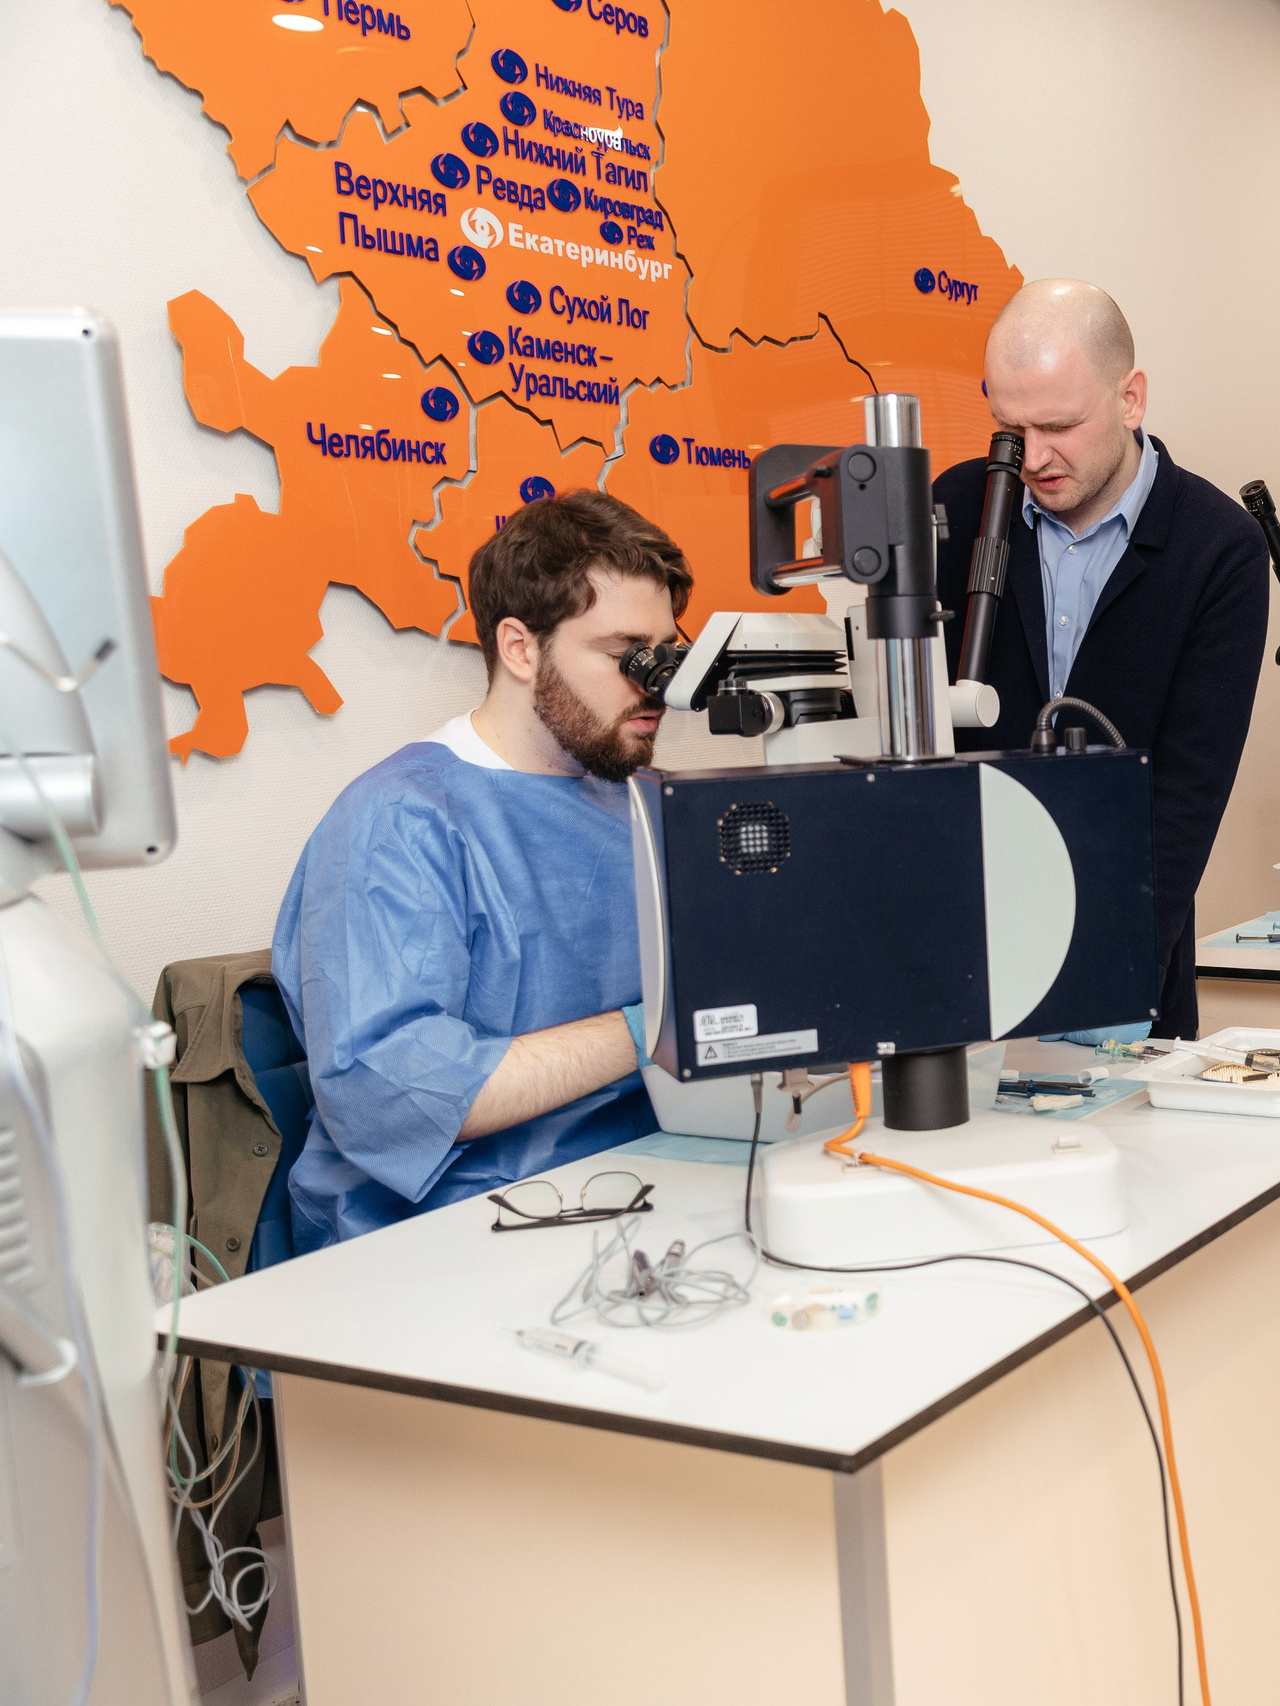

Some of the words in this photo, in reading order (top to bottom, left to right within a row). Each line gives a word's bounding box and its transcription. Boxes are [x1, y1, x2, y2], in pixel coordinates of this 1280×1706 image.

[587, 0, 649, 37] Серов
[535, 64, 602, 105] Нижняя
[605, 86, 645, 120] Тура
[504, 126, 586, 176] Нижний
[591, 151, 648, 192] Тагил
[335, 161, 447, 216] Верхняя
[476, 164, 545, 210] Ревда
[584, 186, 664, 231] Кировград
[338, 212, 439, 262] Пышма
[508, 223, 673, 283] Екатеринбург
[627, 226, 655, 251] Реж
[549, 285, 612, 323] Сухой
[617, 298, 649, 329] Лог
[938, 271, 978, 305] Сургут
[510, 363, 620, 405] Уральский
[306, 422, 446, 465] Челябинск
[682, 438, 752, 469] Тюмень
